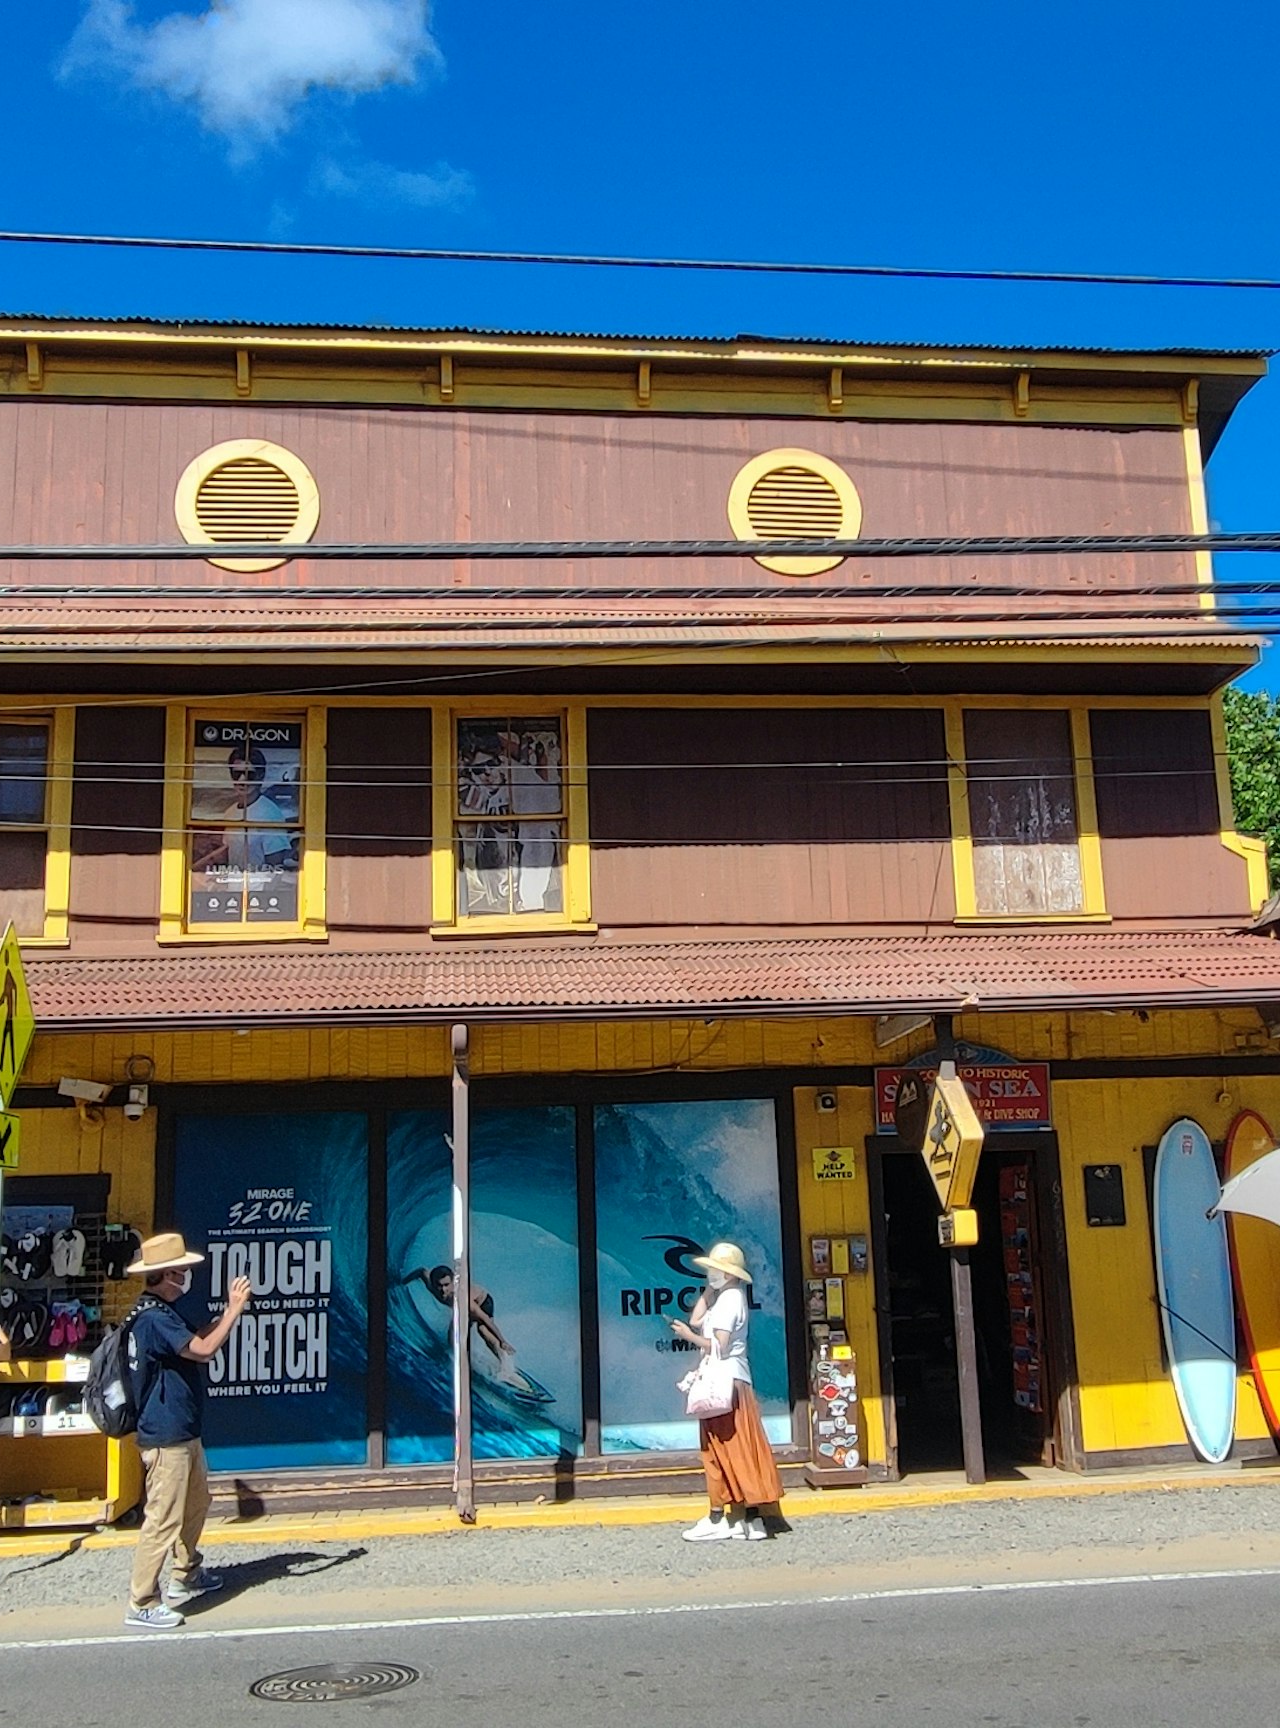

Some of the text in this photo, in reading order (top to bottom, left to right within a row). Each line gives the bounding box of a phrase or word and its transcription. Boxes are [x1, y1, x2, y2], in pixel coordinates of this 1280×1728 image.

[222, 728, 289, 741] DRAGON
[976, 1068, 1031, 1080] HISTORIC
[989, 1080, 1041, 1097] SEA
[994, 1109, 1014, 1119] DIVE
[1016, 1108, 1040, 1119] SHOP
[247, 1188, 294, 1199] MIRAGE
[208, 1240, 331, 1297] TOUGH
[208, 1298, 330, 1312] WHE YOU NEED IT
[621, 1284, 762, 1316] RIP CL
[208, 1382, 327, 1397] WHERE YOU FEEL IT
